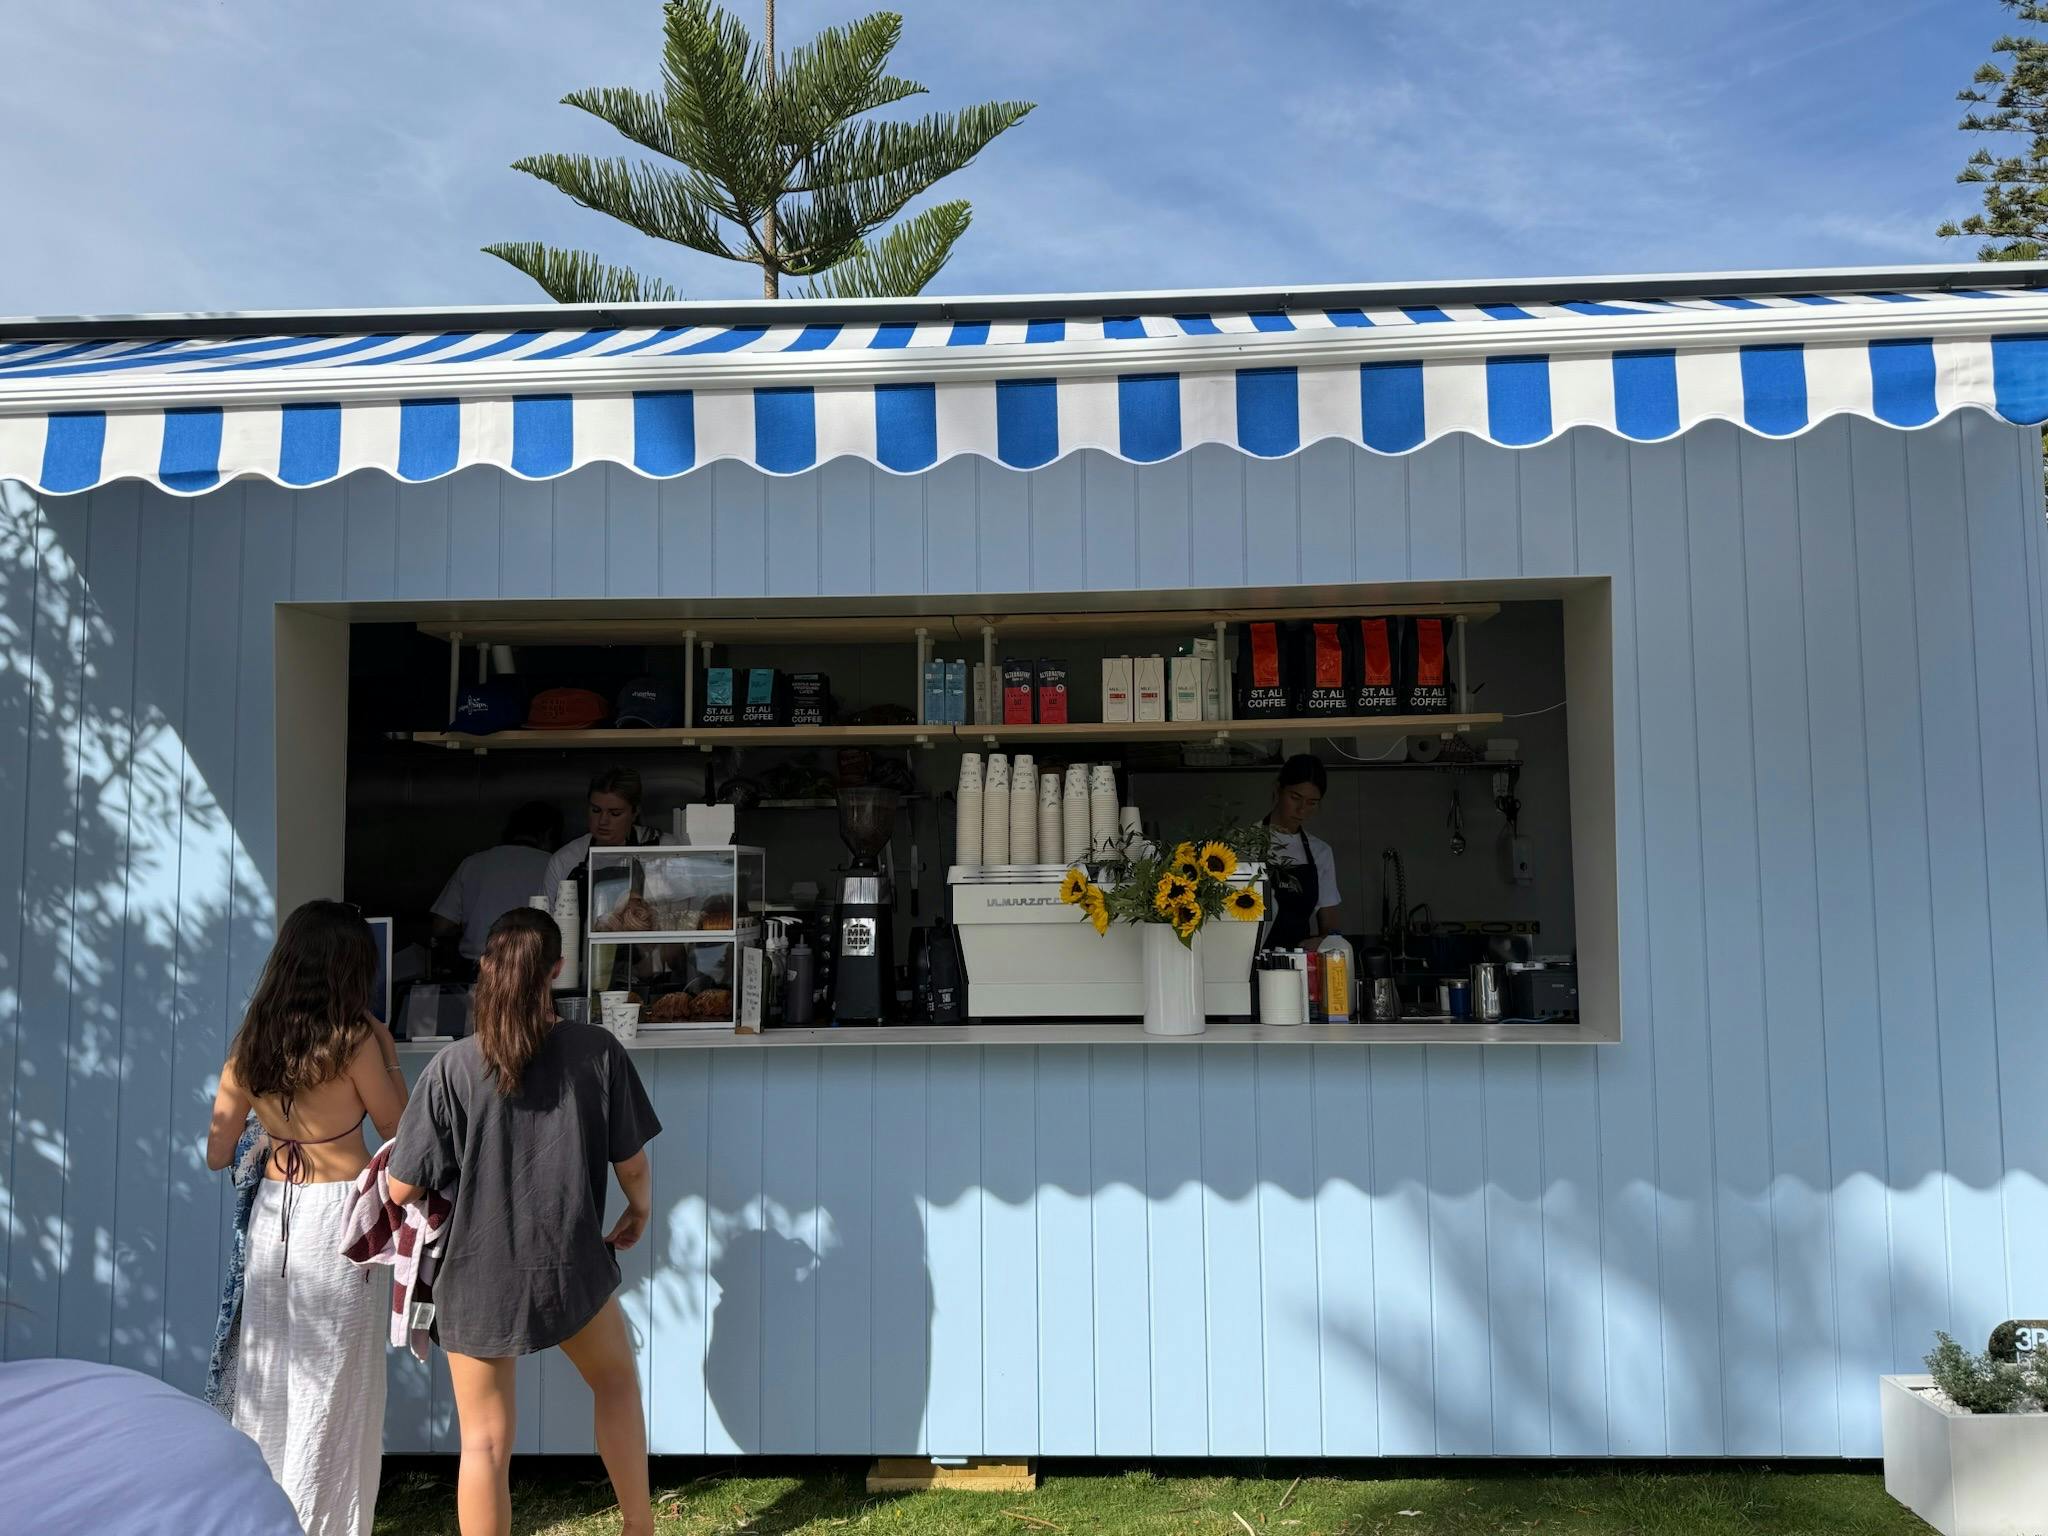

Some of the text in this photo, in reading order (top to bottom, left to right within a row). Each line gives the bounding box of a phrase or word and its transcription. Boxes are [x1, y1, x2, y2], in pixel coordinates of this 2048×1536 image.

[1250, 689, 1266, 699] ST.
[1311, 689, 1327, 699] ST.
[1361, 687, 1377, 697] ST.
[1413, 687, 1429, 697] ST.
[1247, 698, 1287, 709] COFFEE
[1308, 699, 1348, 709] COFFEE
[1358, 697, 1398, 707] COFFEE
[1410, 697, 1448, 707] COFFEE
[702, 714, 735, 722] COFFEE
[742, 713, 774, 721] COFFEE
[791, 715, 823, 723] COFFEE
